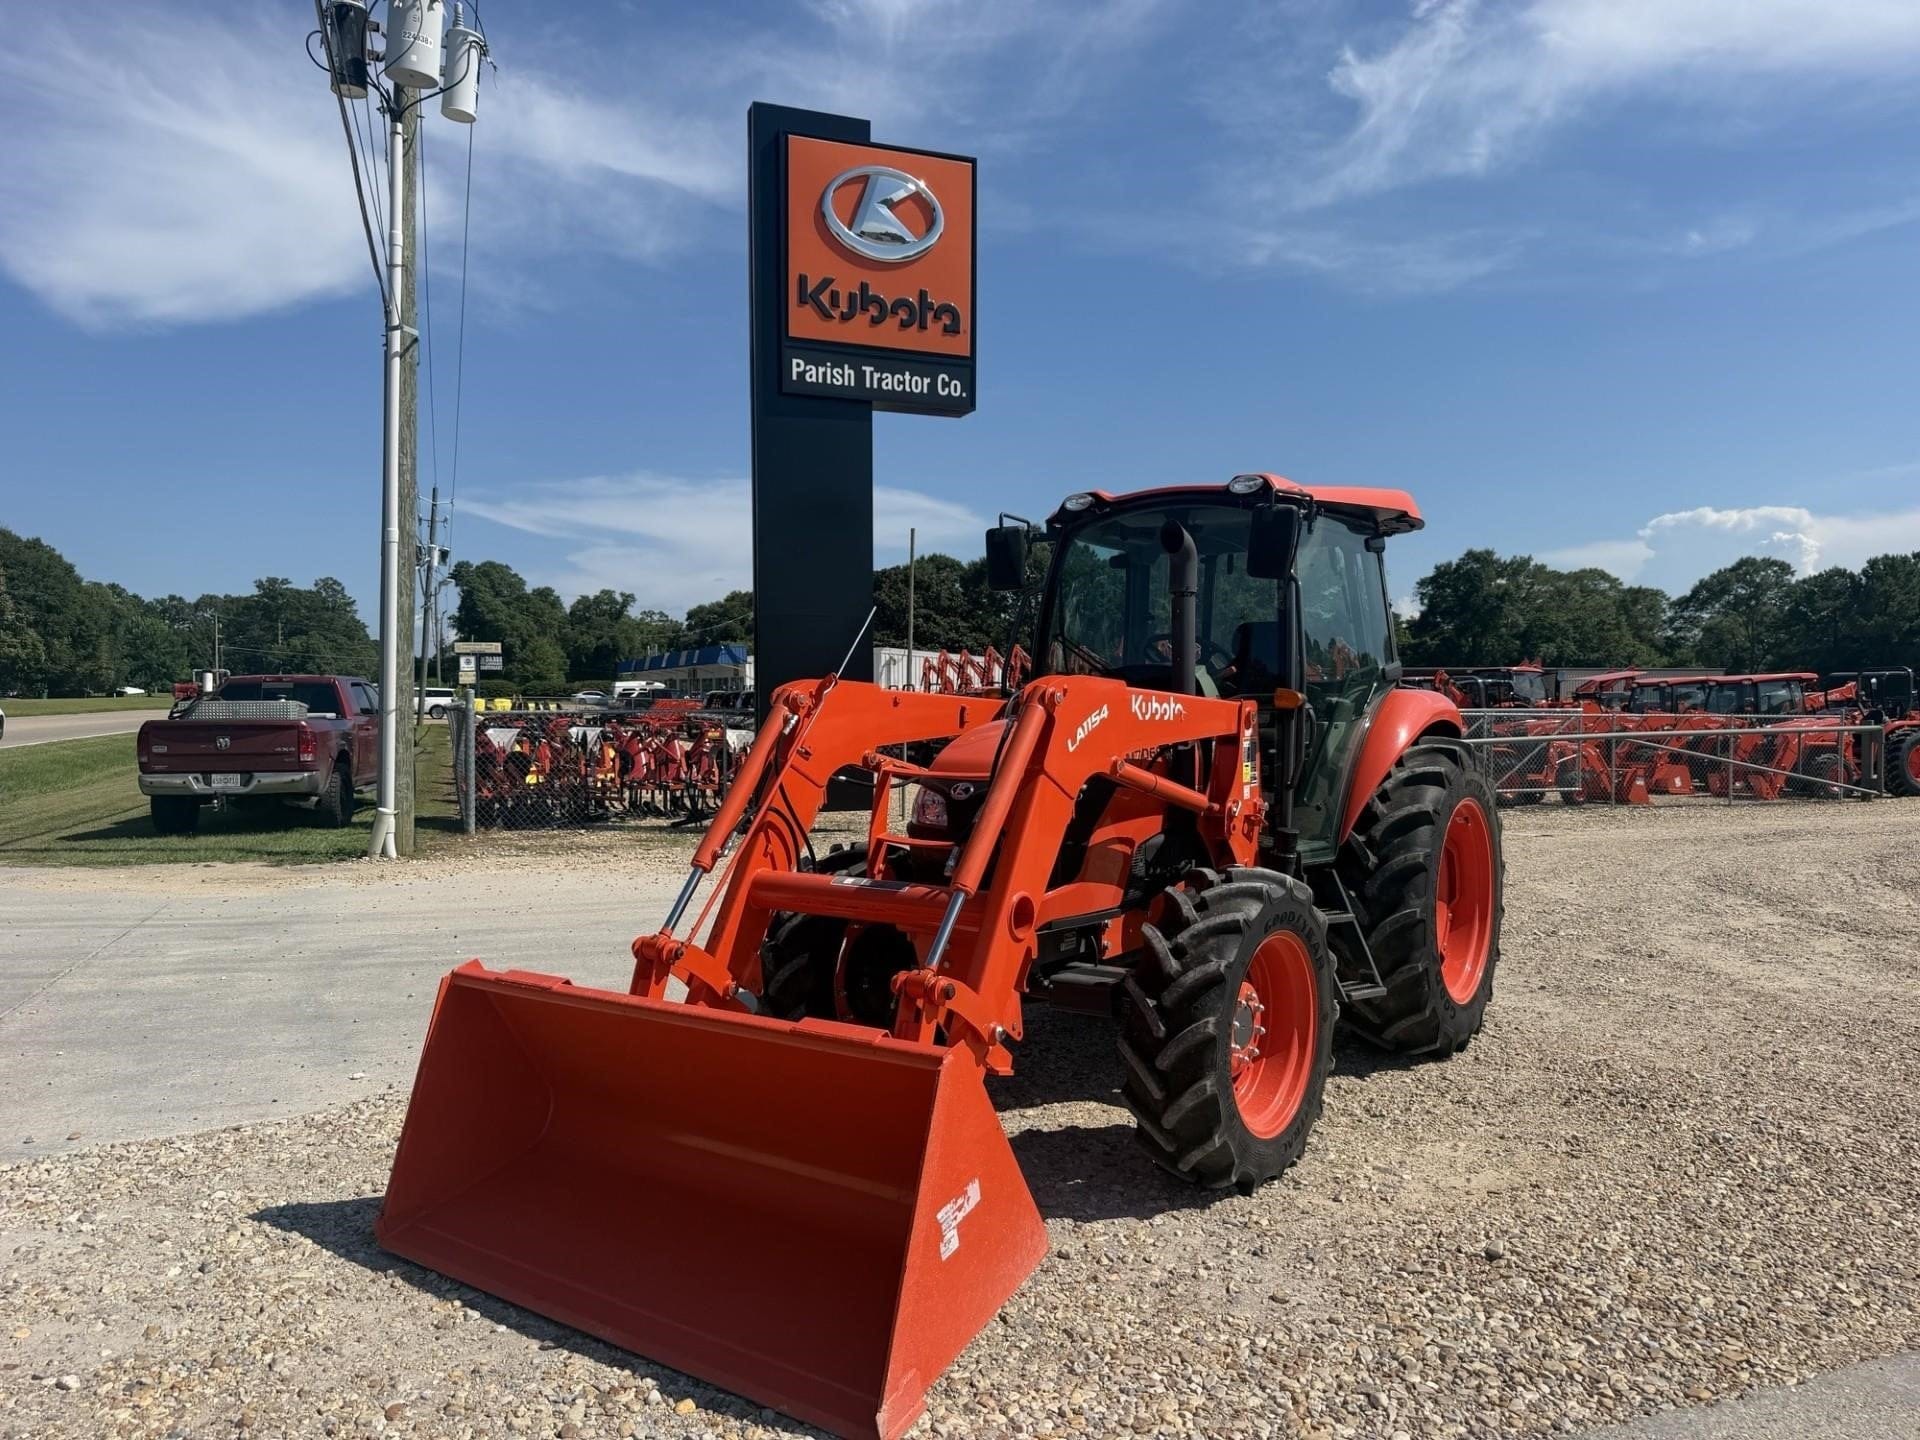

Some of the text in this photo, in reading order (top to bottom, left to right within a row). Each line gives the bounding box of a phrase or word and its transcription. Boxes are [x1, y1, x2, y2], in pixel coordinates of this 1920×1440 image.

[798, 273, 961, 335] Kubota
[792, 358, 967, 397] Parish Tractor Co.
[1066, 704, 1109, 753] LA1154
[1131, 694, 1184, 721] Kubota
